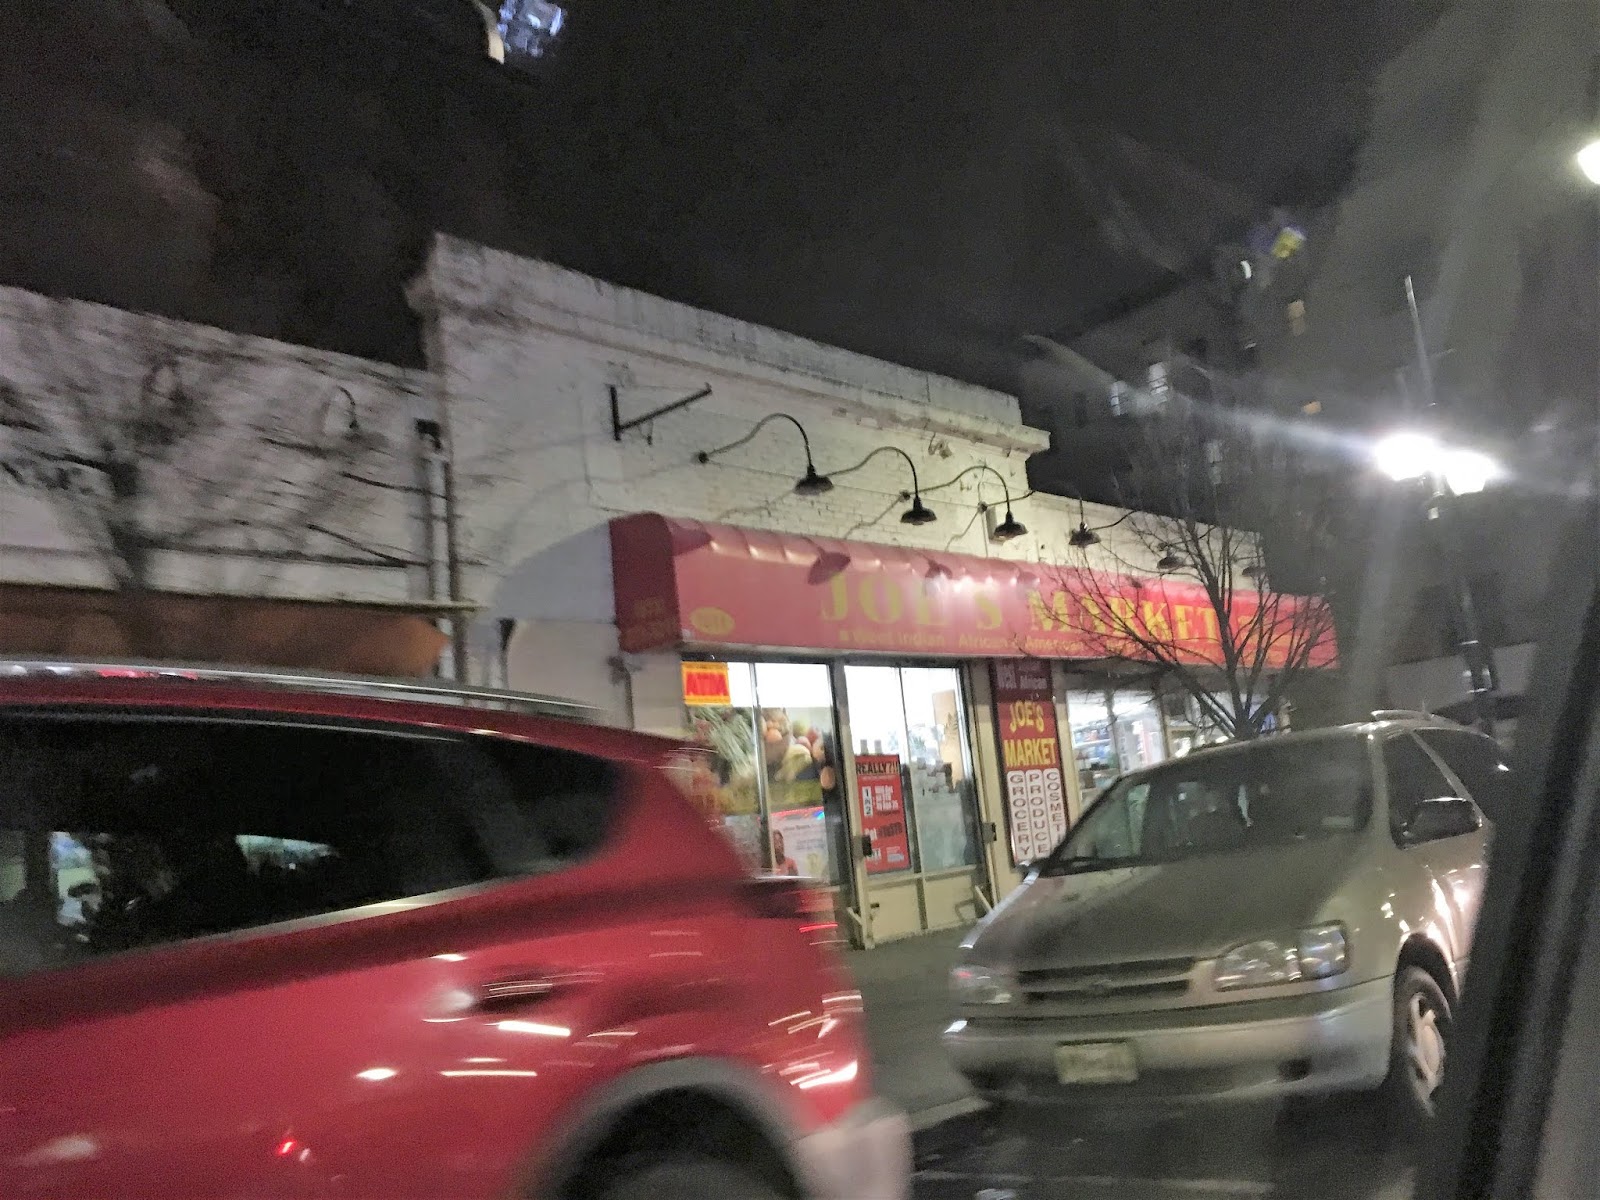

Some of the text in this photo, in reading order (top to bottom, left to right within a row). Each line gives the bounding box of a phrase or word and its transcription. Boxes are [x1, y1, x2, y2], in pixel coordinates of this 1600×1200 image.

[820, 572, 1003, 630] JOES
[1025, 588, 1221, 643] MARKET
[1009, 700, 1045, 733] JOE'S
[1003, 738, 1056, 768] MARKET
[1010, 773, 1030, 856] GROCERY
[1029, 773, 1048, 854] PRODUCE
[1046, 771, 1063, 844] COSMETI
